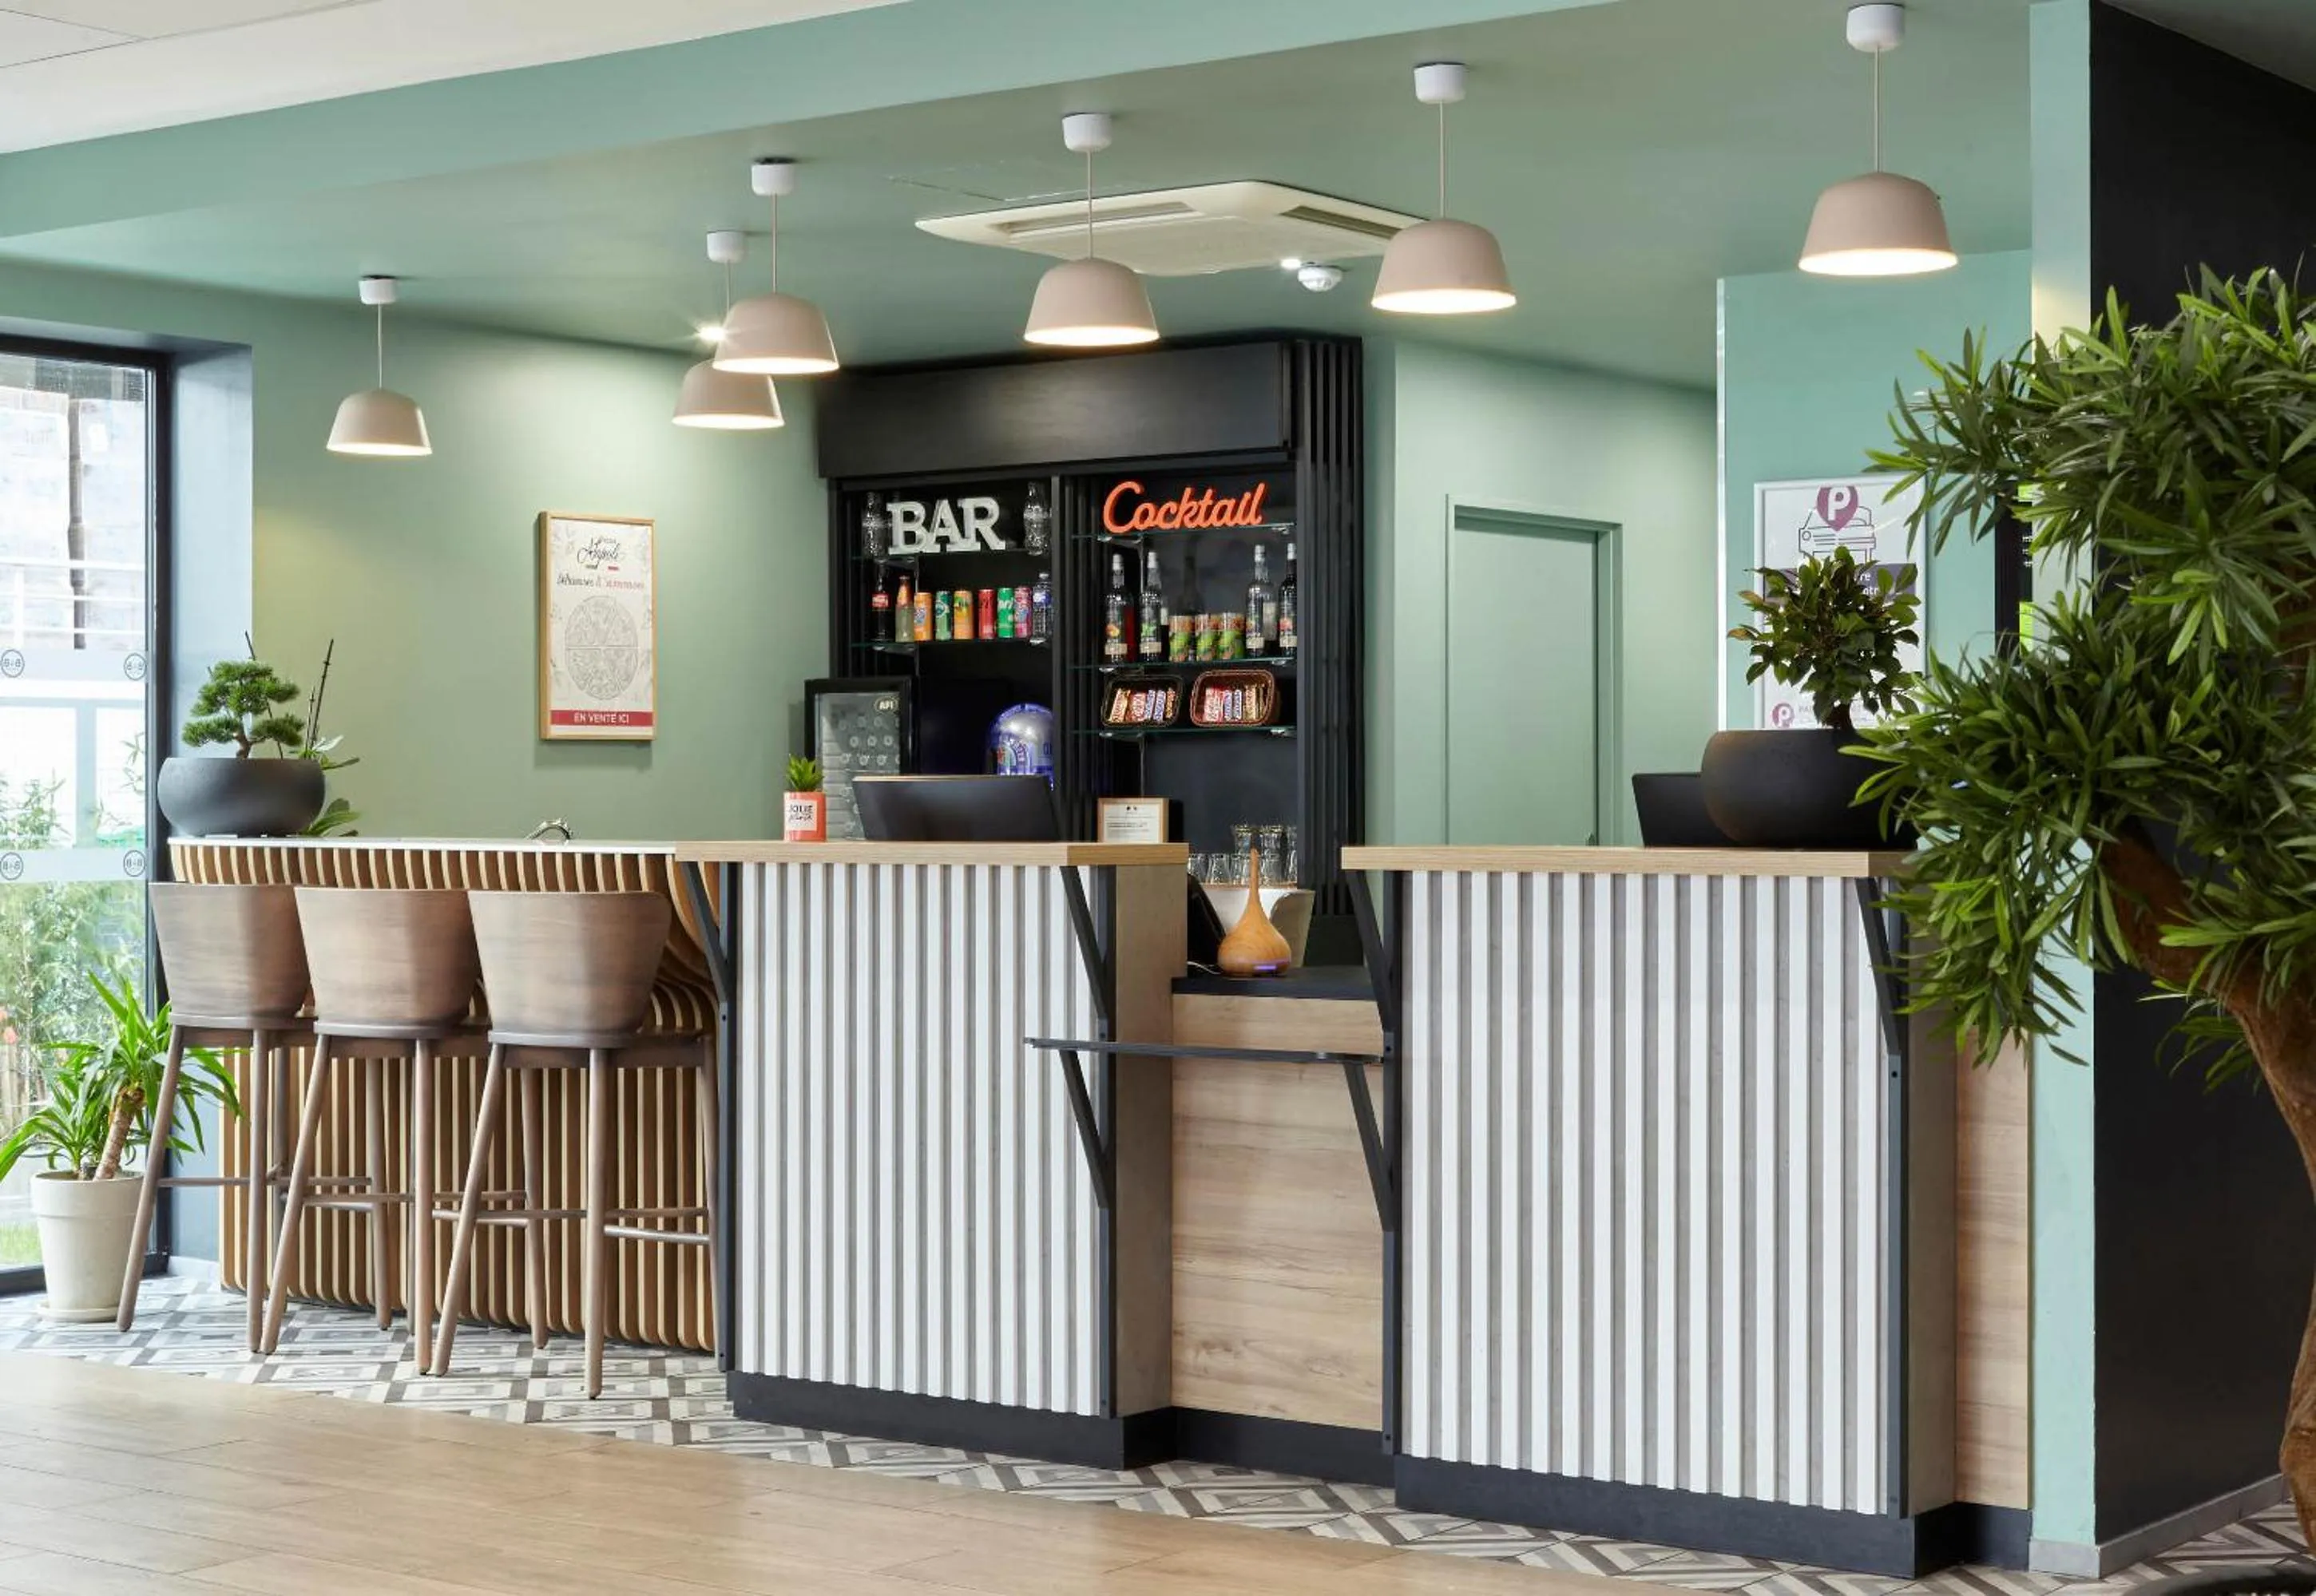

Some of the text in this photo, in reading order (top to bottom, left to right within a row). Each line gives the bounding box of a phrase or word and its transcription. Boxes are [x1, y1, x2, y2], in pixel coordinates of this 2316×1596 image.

[886, 497, 1006, 555] BAR
[1103, 481, 1266, 533] Cocktail
[573, 712, 629, 724] EN VENTE ICI
